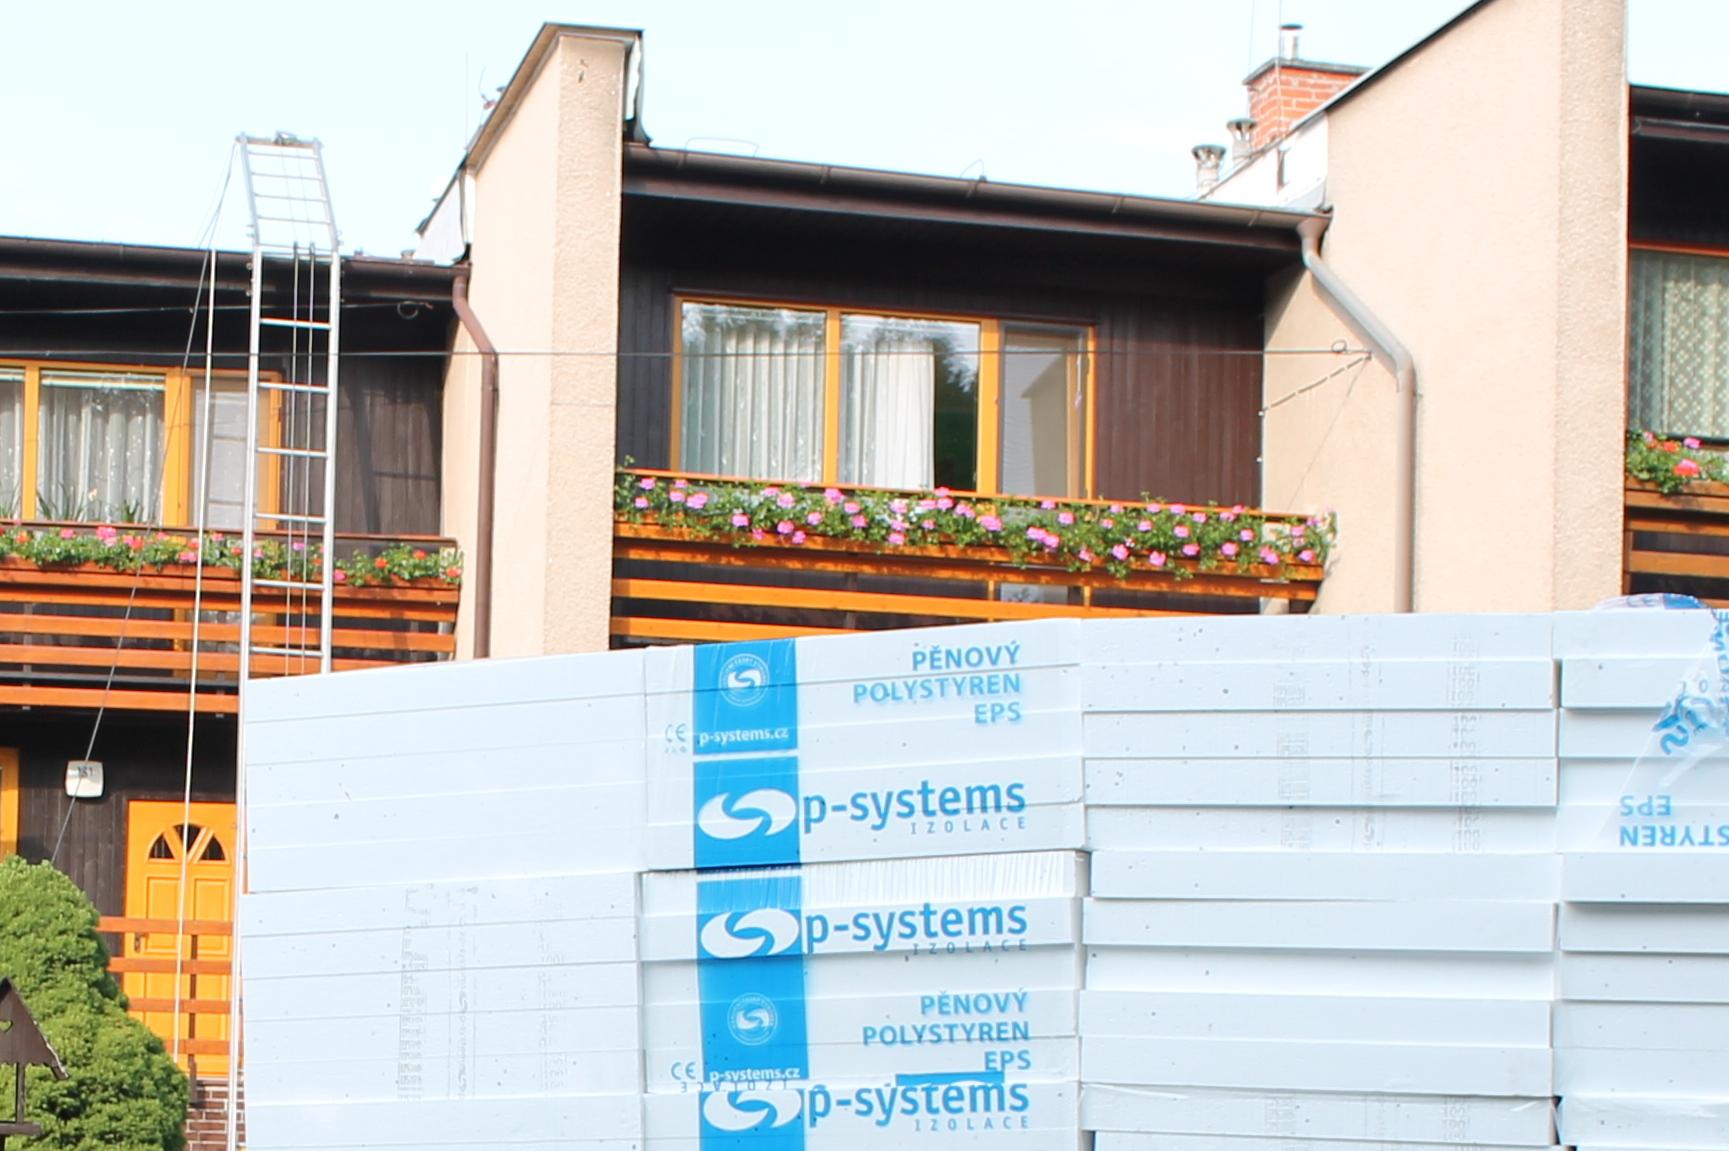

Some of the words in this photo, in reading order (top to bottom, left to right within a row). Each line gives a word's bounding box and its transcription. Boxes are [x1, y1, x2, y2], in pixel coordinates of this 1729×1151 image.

[912, 643, 1020, 671] PĚNOVÝ
[853, 673, 1020, 703] POLYSTYREN
[974, 703, 1021, 725] EPS
[699, 728, 789, 747] p-systems.cz
[803, 779, 1025, 834] p-systems
[1620, 795, 1672, 816] EPS
[911, 816, 1025, 835] IZOLACE
[806, 903, 1027, 954] p-systems
[913, 938, 1027, 955] IZOLACE
[921, 988, 1028, 1015] PĚNOVÝ
[863, 1020, 1029, 1045] POLYSTYREN
[984, 1050, 1030, 1071] EPS
[709, 1067, 800, 1082] p-systems.cz
[809, 1081, 1029, 1128] p-systems
[915, 1116, 1029, 1132] IZOLACE
